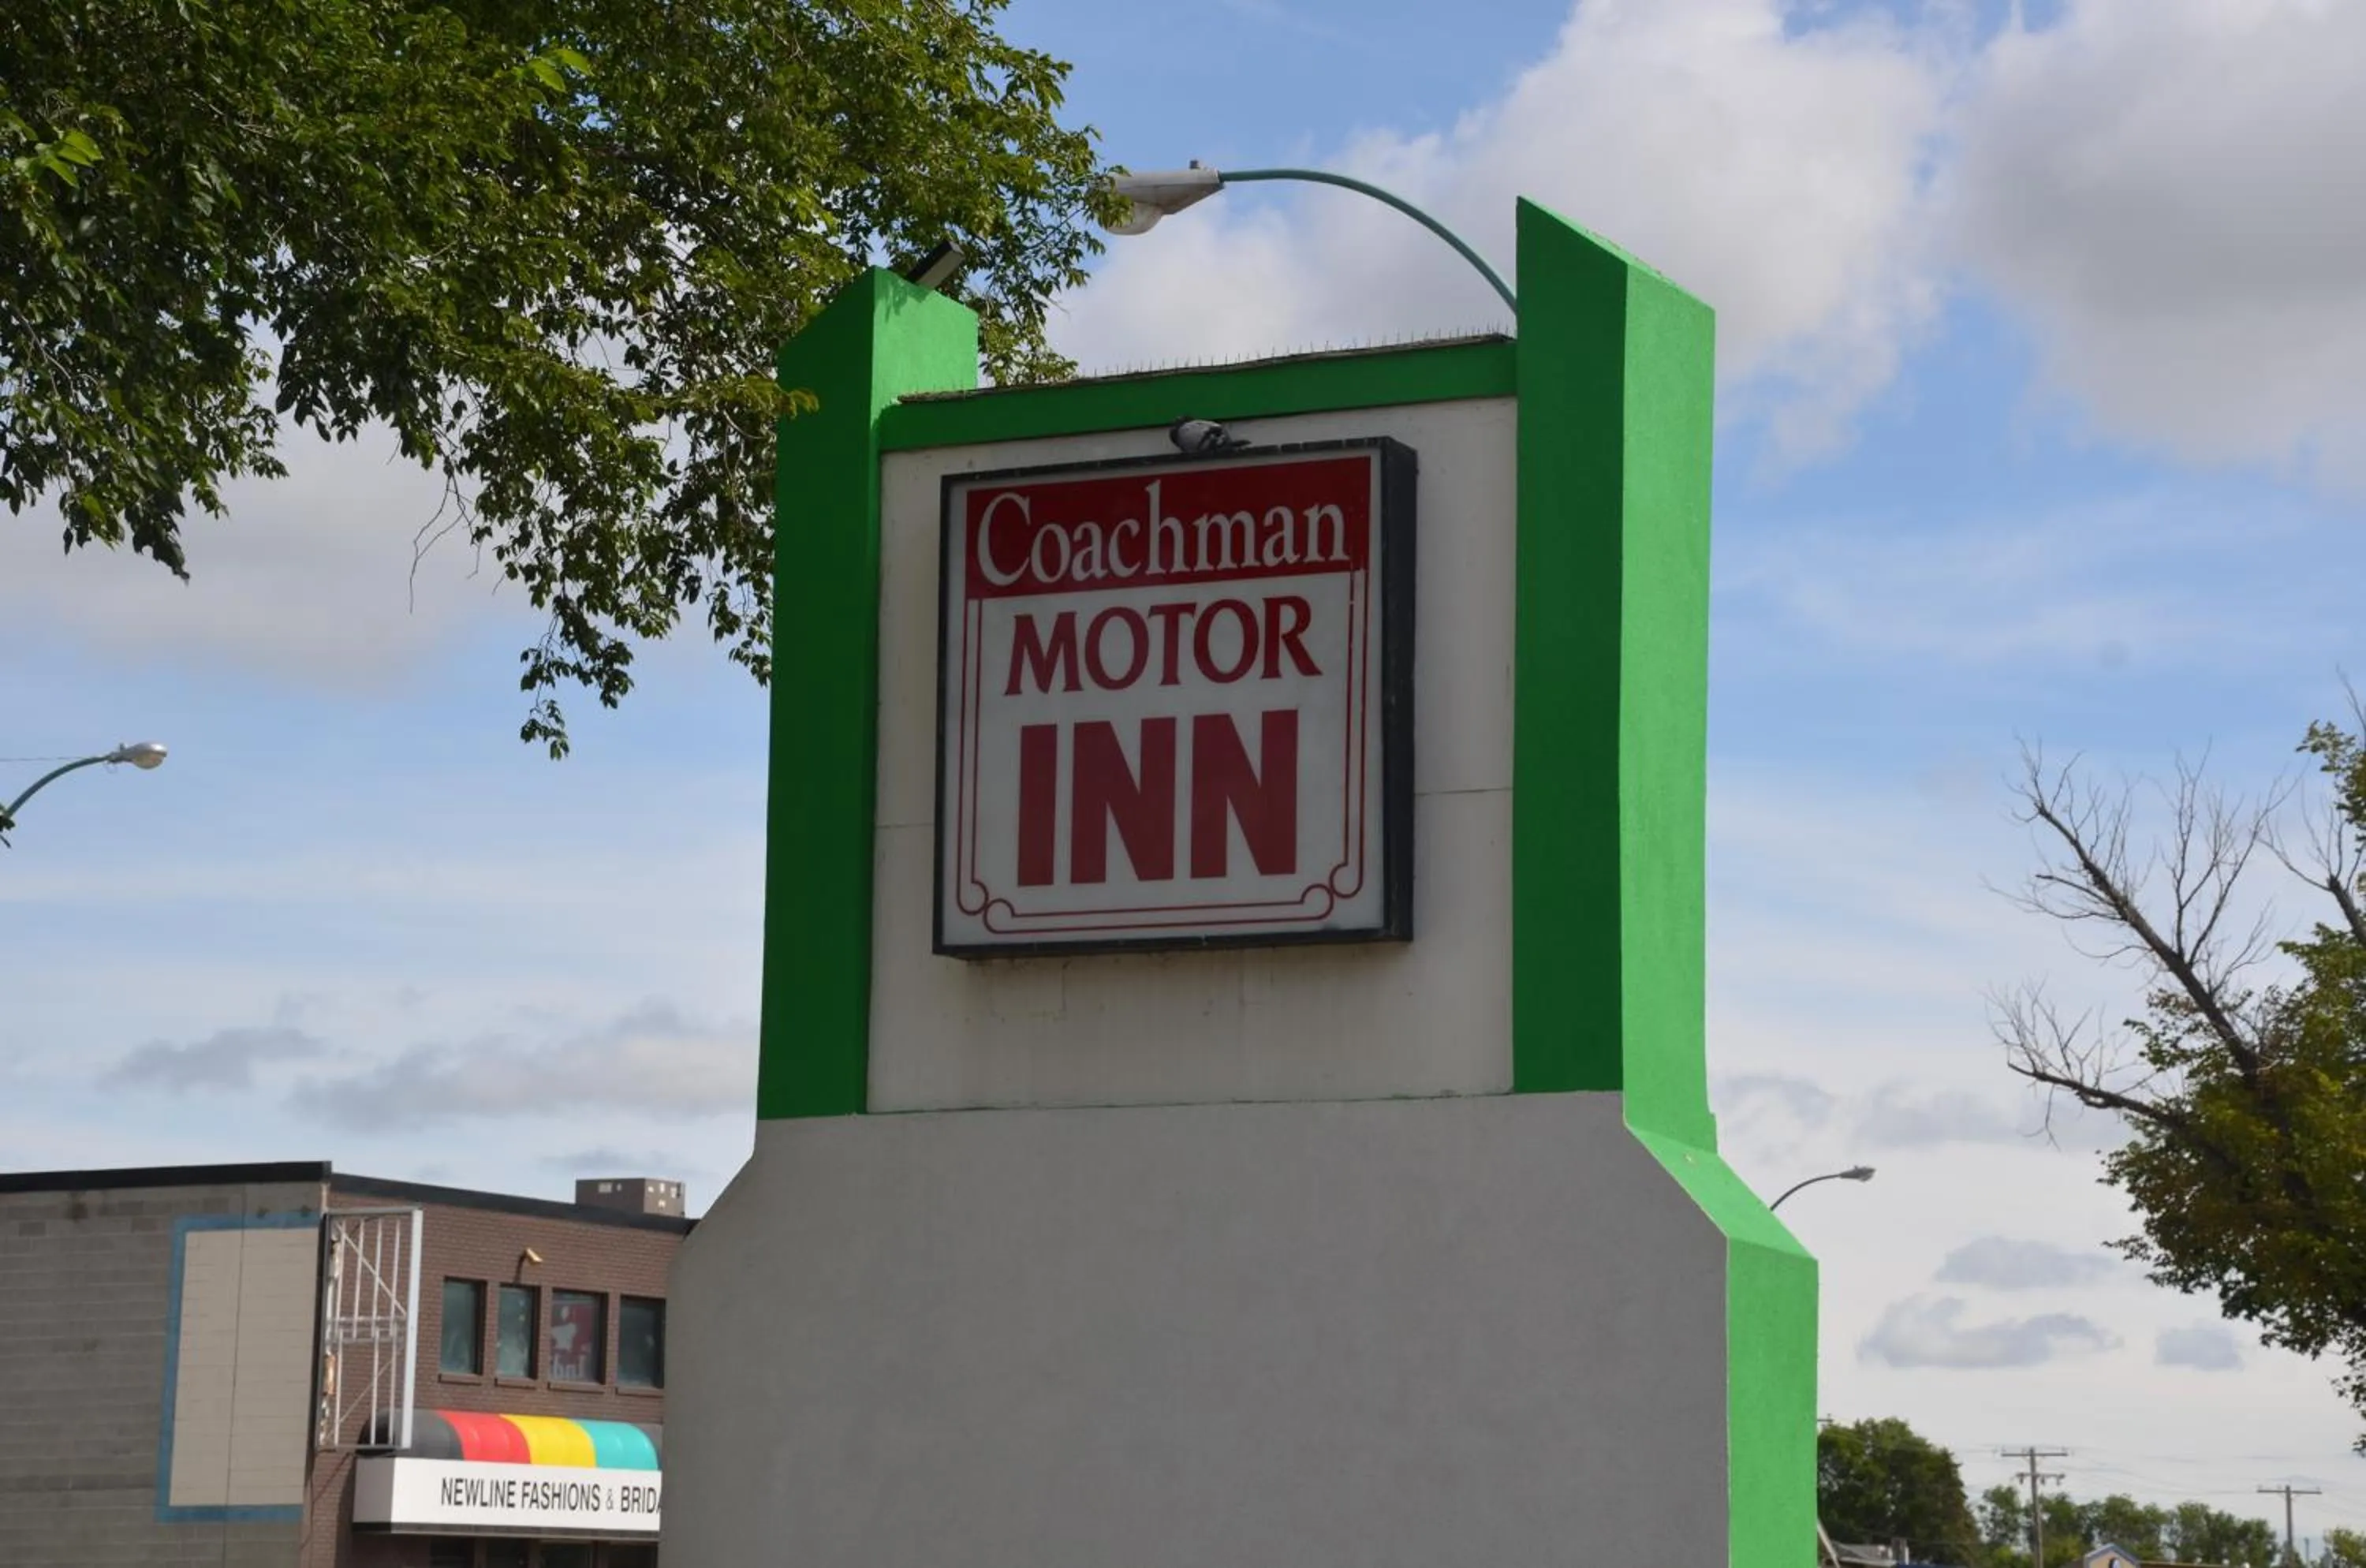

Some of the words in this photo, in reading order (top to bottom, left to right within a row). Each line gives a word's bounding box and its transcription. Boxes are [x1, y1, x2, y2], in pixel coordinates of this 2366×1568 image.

[978, 480, 1349, 586] Coachman
[1004, 595, 1323, 696] MOTOR
[1017, 708, 1298, 887] INN
[441, 1477, 516, 1508] NEWLINE
[521, 1481, 600, 1511] FASHIONS
[606, 1488, 614, 1510] &
